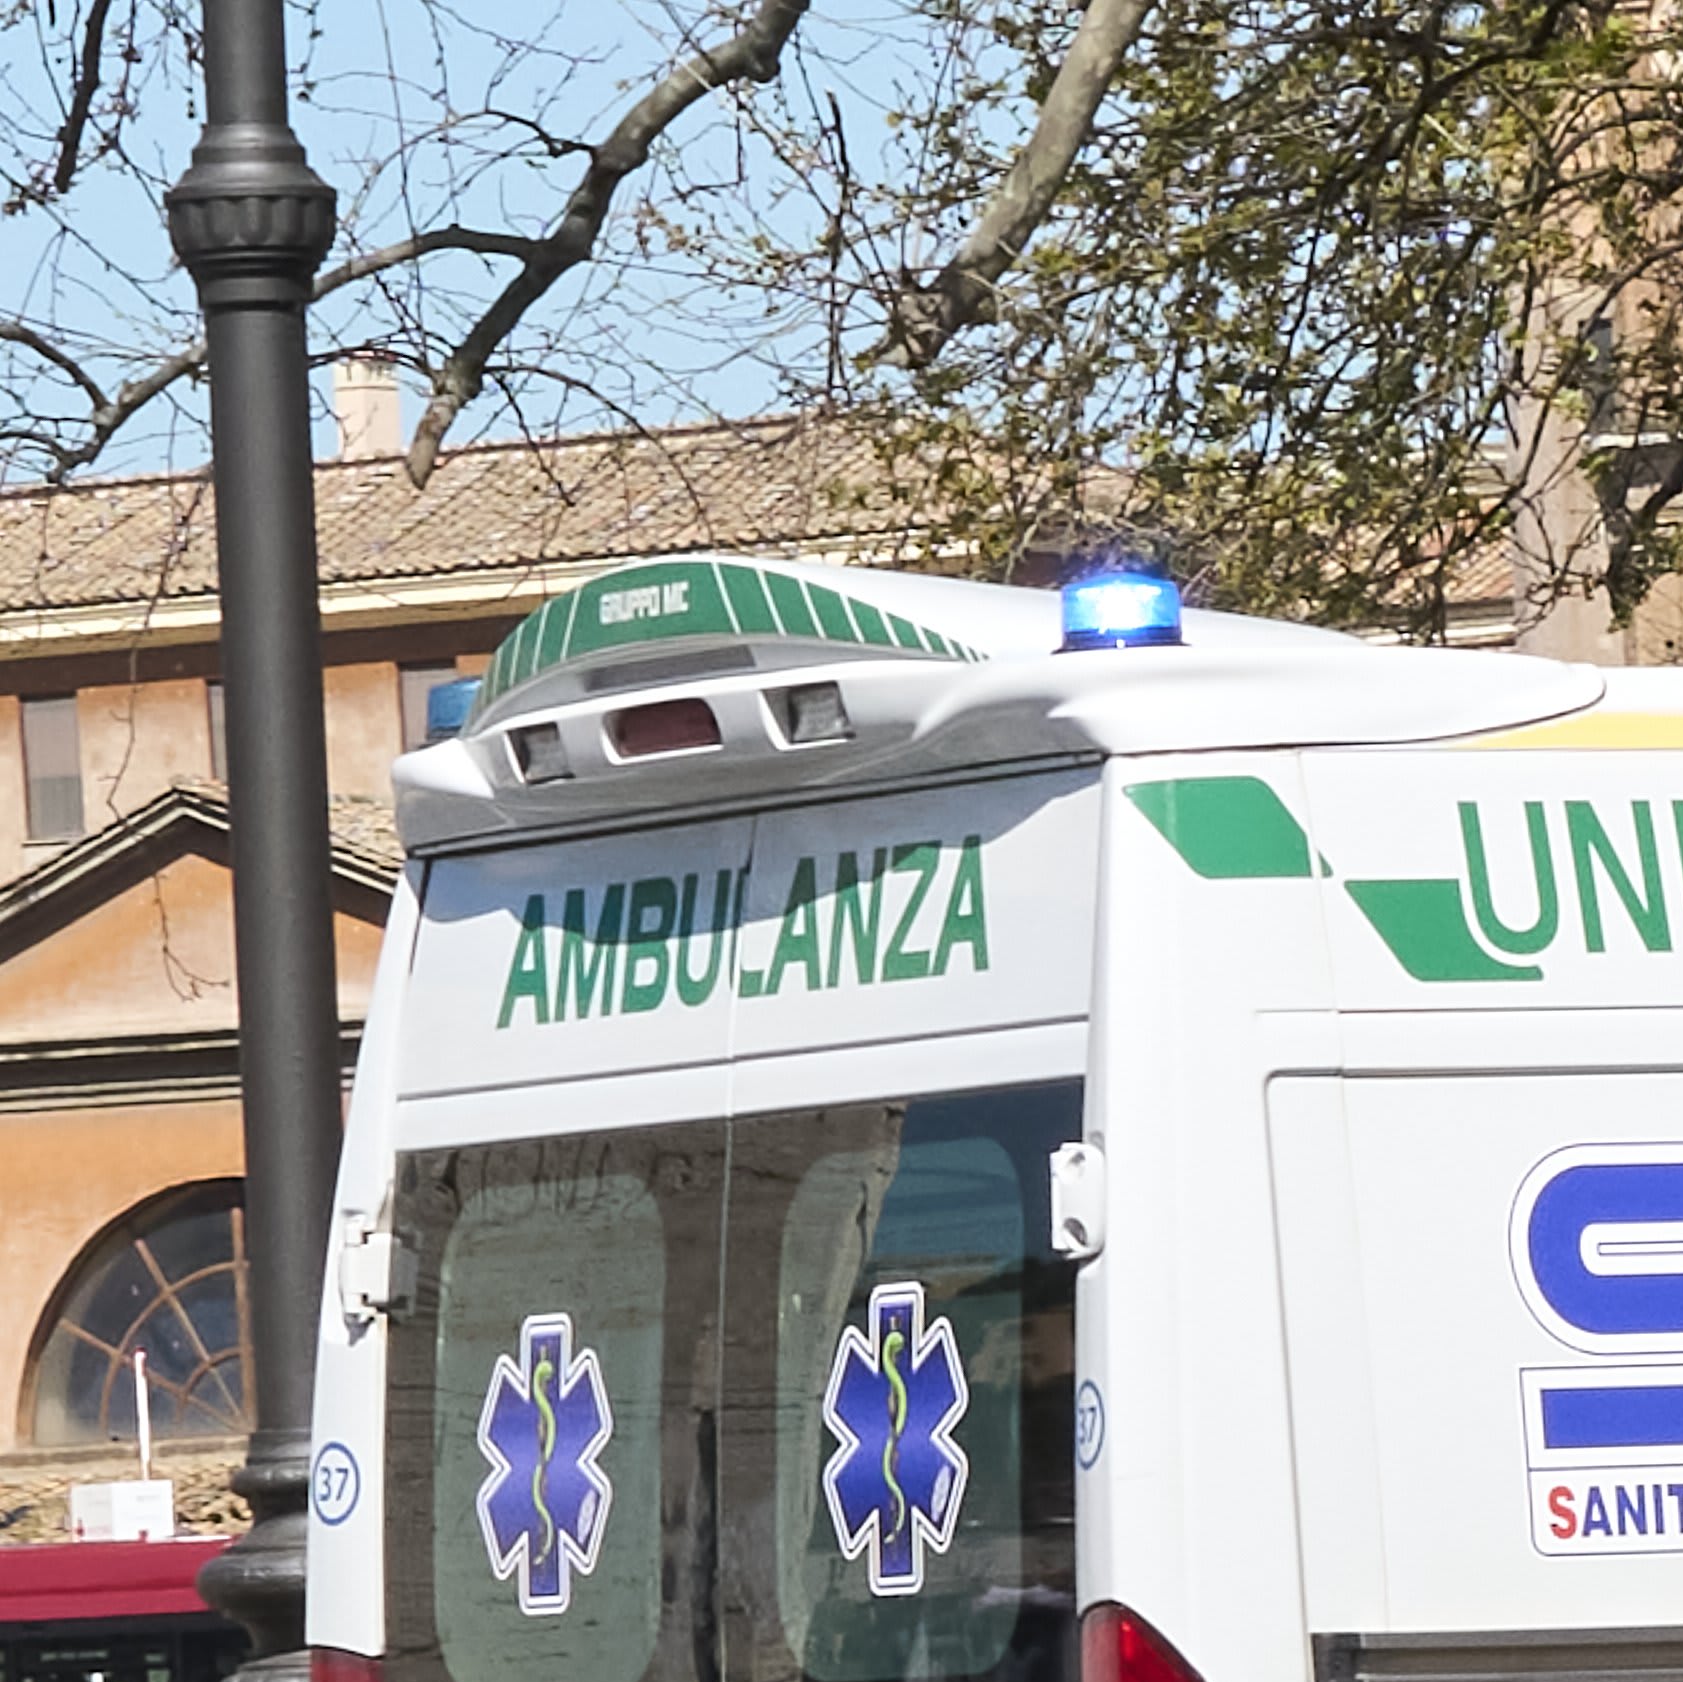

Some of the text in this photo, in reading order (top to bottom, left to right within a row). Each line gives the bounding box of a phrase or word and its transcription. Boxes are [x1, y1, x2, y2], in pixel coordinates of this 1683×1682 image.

[599, 580, 690, 625] GRUPPO MC
[496, 833, 990, 1029] AMBULANZA
[319, 1466, 349, 1502] 37
